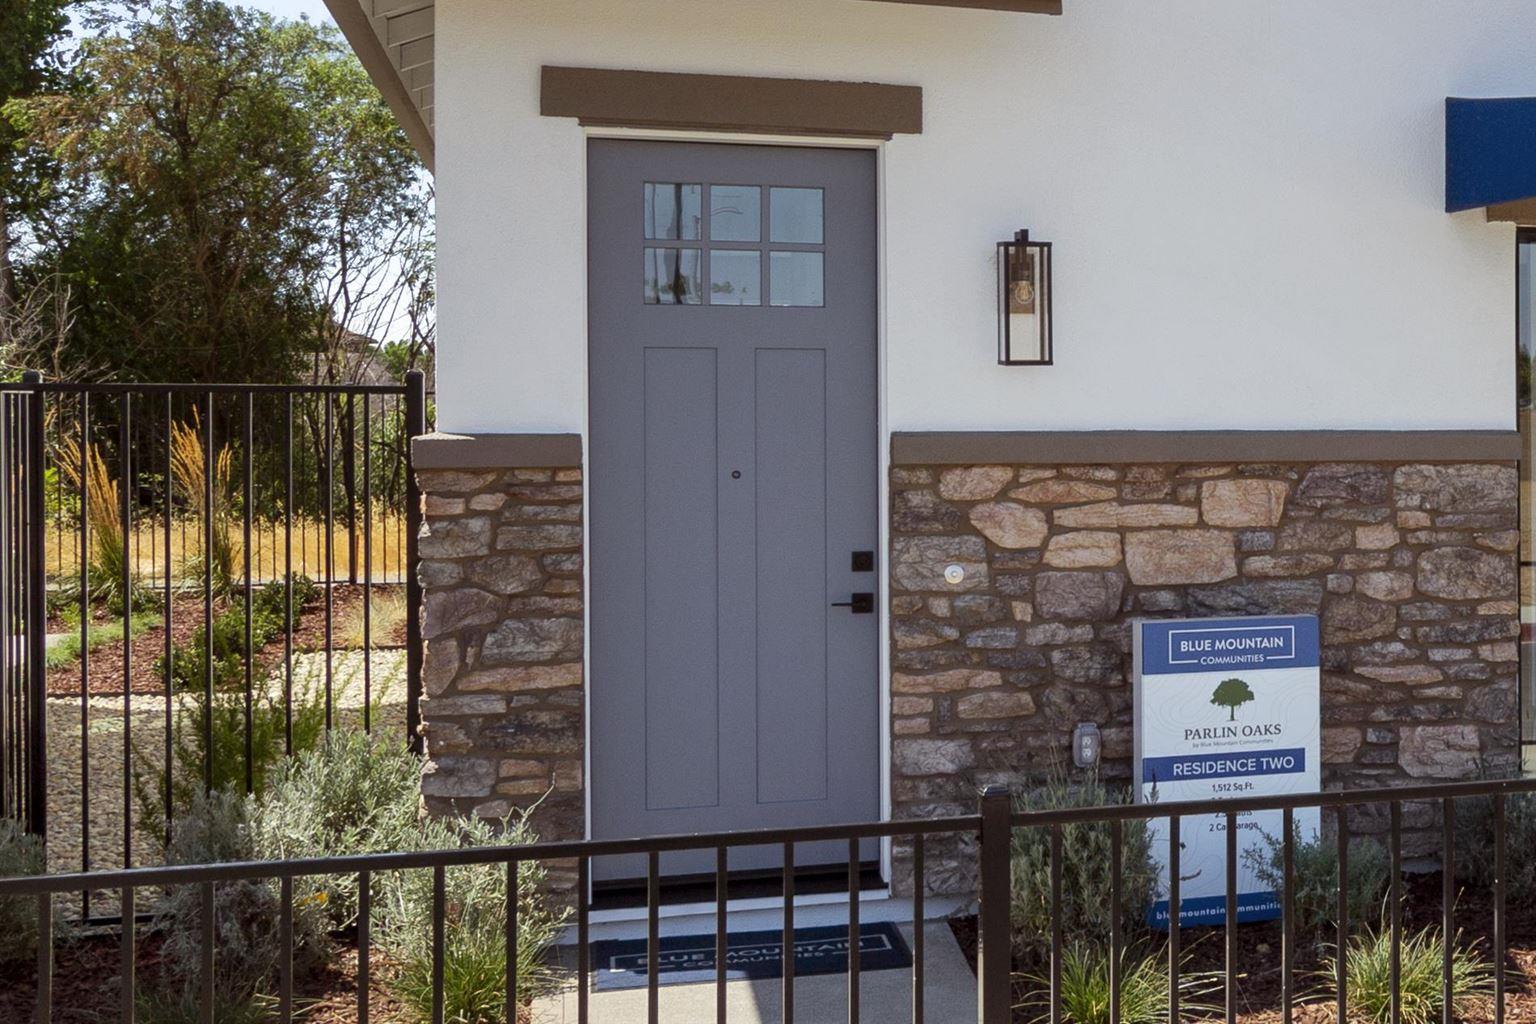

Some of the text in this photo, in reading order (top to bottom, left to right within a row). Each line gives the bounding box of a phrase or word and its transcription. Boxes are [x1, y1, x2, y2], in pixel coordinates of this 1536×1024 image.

[1180, 636, 1283, 652] BLUE MOUNTAIN
[1200, 654, 1264, 665] COMMUNITIES
[1184, 724, 1281, 740] PARLIN OAKS
[1173, 756, 1295, 776] RESIDENCE TWO
[1212, 783, 1231, 793] 1,512
[1209, 823, 1214, 832] 2
[1236, 821, 1258, 830] arage
